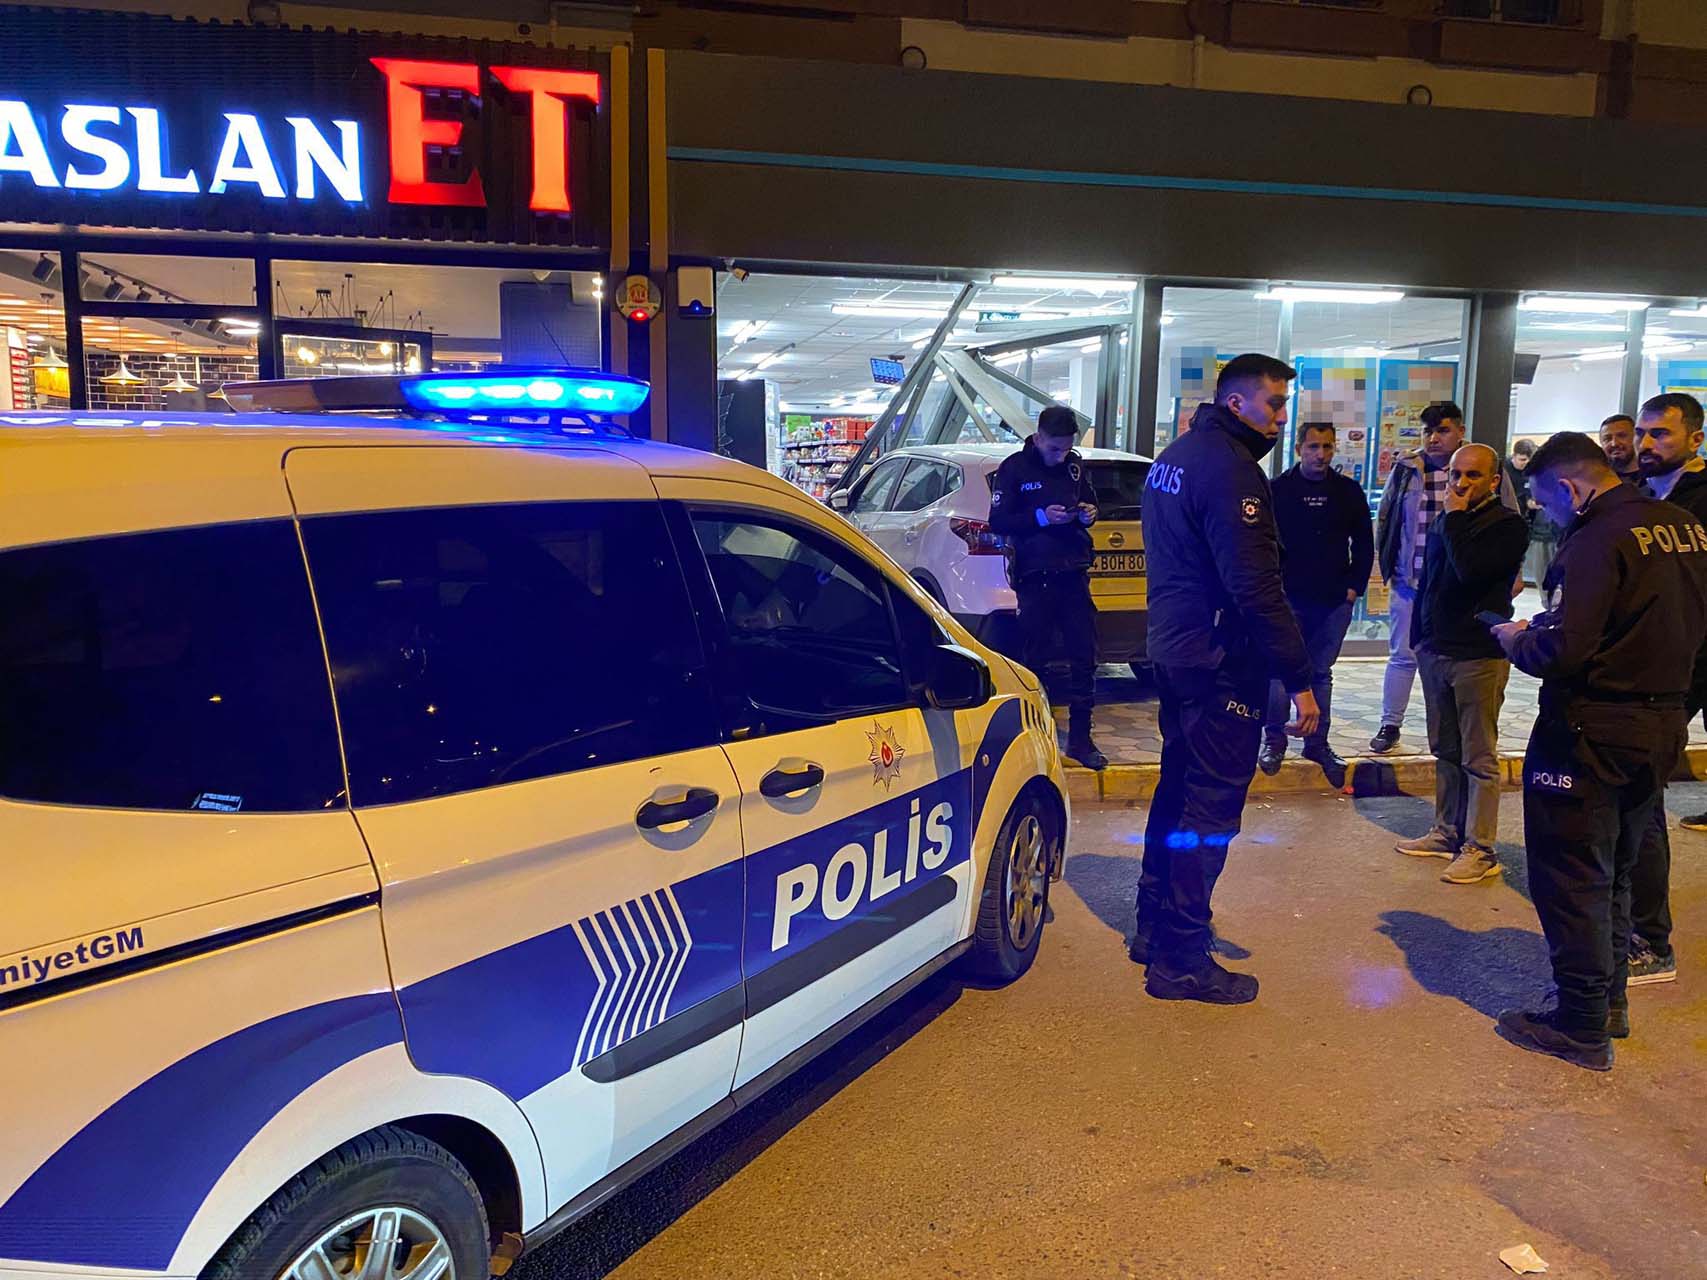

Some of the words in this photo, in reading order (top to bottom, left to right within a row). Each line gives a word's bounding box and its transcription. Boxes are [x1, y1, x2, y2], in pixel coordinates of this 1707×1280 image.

[0, 100, 364, 202] ASLAN
[368, 57, 600, 212] ET
[1101, 555, 1125, 571] BOH
[0, 926, 144, 986] niyetGM
